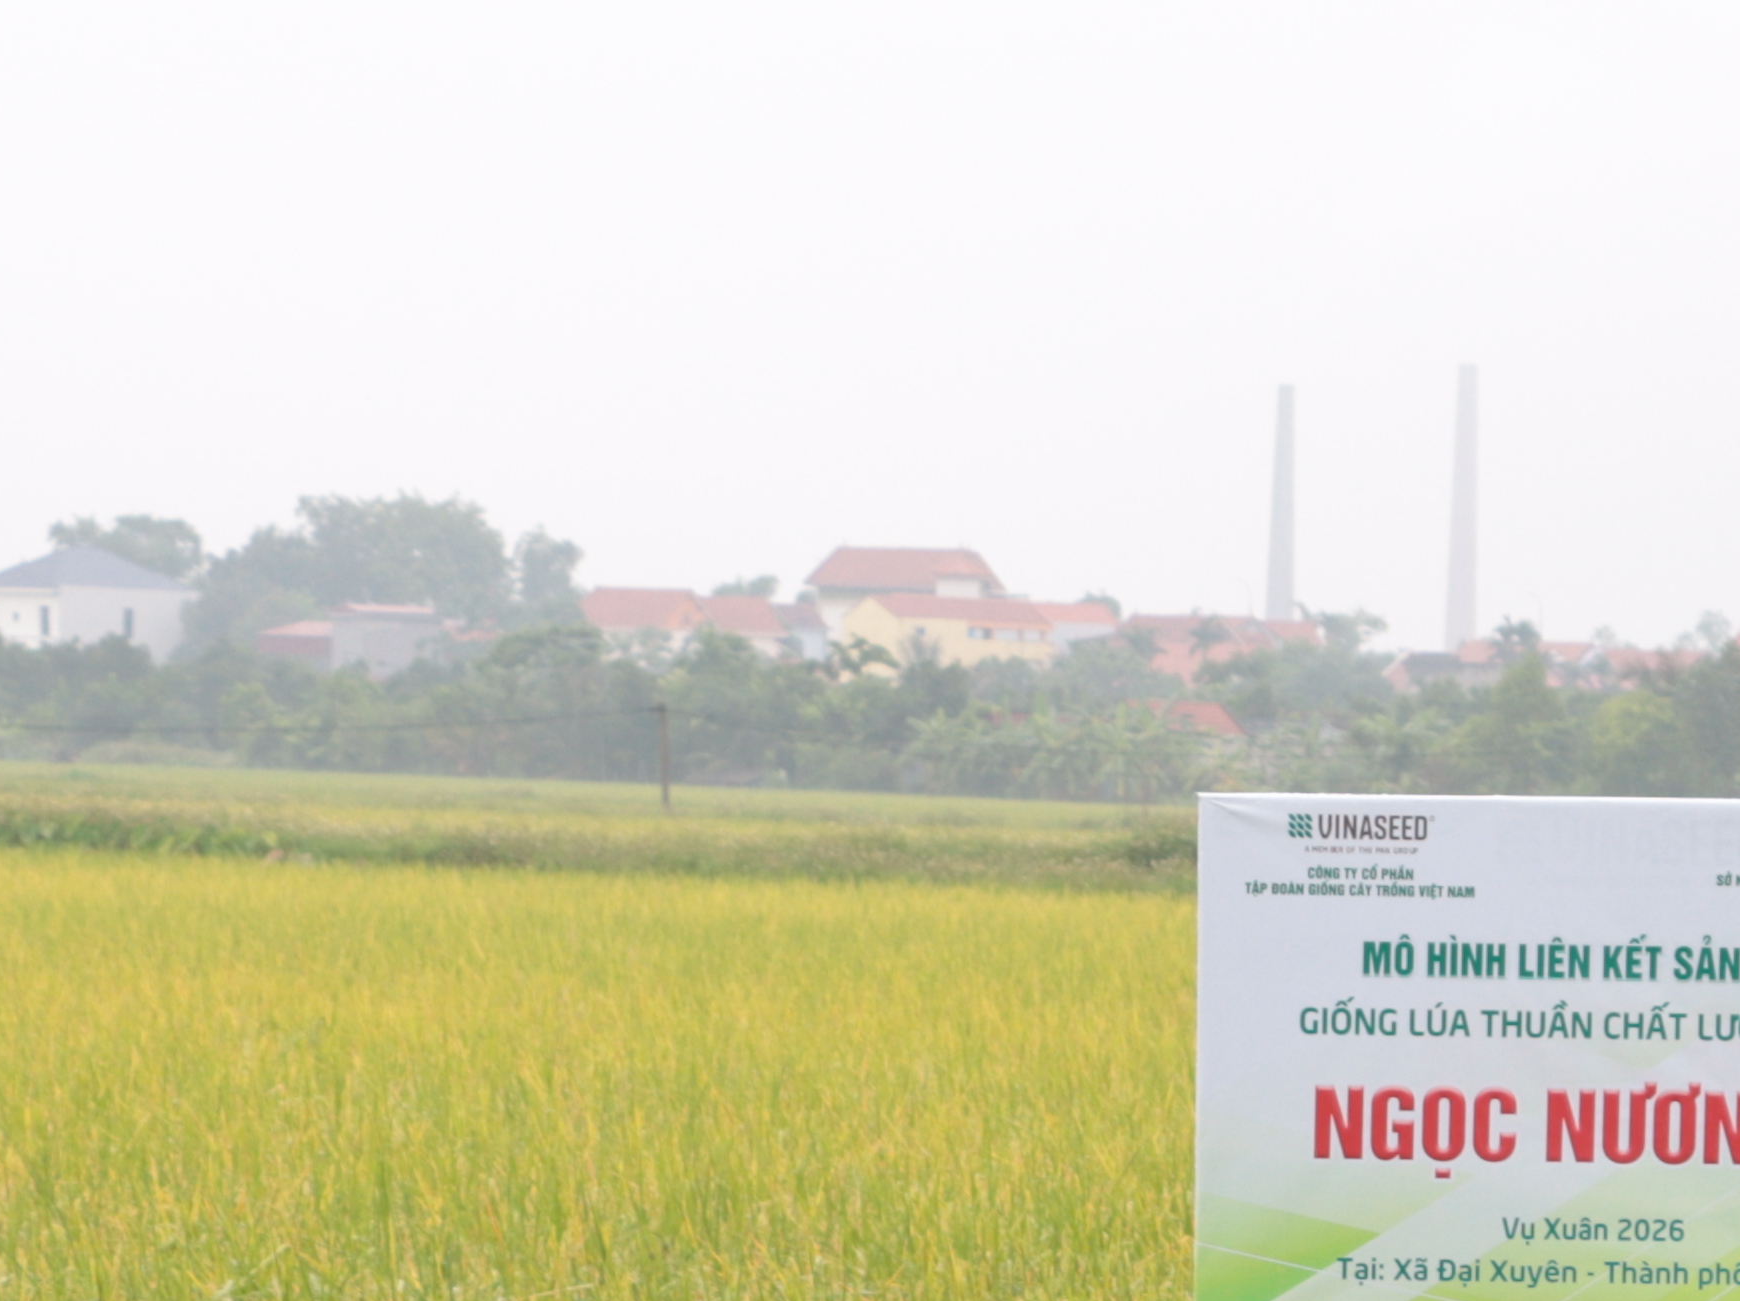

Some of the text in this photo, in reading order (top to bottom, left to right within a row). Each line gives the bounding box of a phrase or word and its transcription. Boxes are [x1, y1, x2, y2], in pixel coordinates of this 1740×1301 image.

[1318, 814, 1427, 840] VINASEED
[1308, 865, 1341, 880] CÔNG
[1344, 867, 1357, 879] TY
[1245, 880, 1268, 897] TẬP
[1272, 881, 1304, 895] ĐOÀN
[1308, 880, 1345, 896] GIỐNG
[1349, 882, 1372, 896] CÂY
[1419, 883, 1443, 900] VIỆT
[1448, 885, 1475, 898] NAM
[1363, 934, 1414, 977] MÔ
[1427, 936, 1505, 977] HÌNH
[1519, 937, 1590, 979] LIÊN
[1603, 935, 1662, 981] KẾT
[1674, 936, 1740, 981] SẢN
[1300, 997, 1396, 1036] GIỐNG
[1410, 1002, 1470, 1036] LÚA
[1481, 1001, 1592, 1038] THUẦN
[1604, 1002, 1687, 1039] CHẤT
[1313, 1085, 1517, 1178] NGỌC
[1503, 1218, 1684, 1245] Vụ Xuân 2026
[1336, 1257, 1383, 1285] Tại:
[1395, 1258, 1428, 1281] Xã
[1437, 1259, 1480, 1287] Đại
[1491, 1260, 1576, 1288] Xuyên
[1604, 1261, 1688, 1284] Thành
